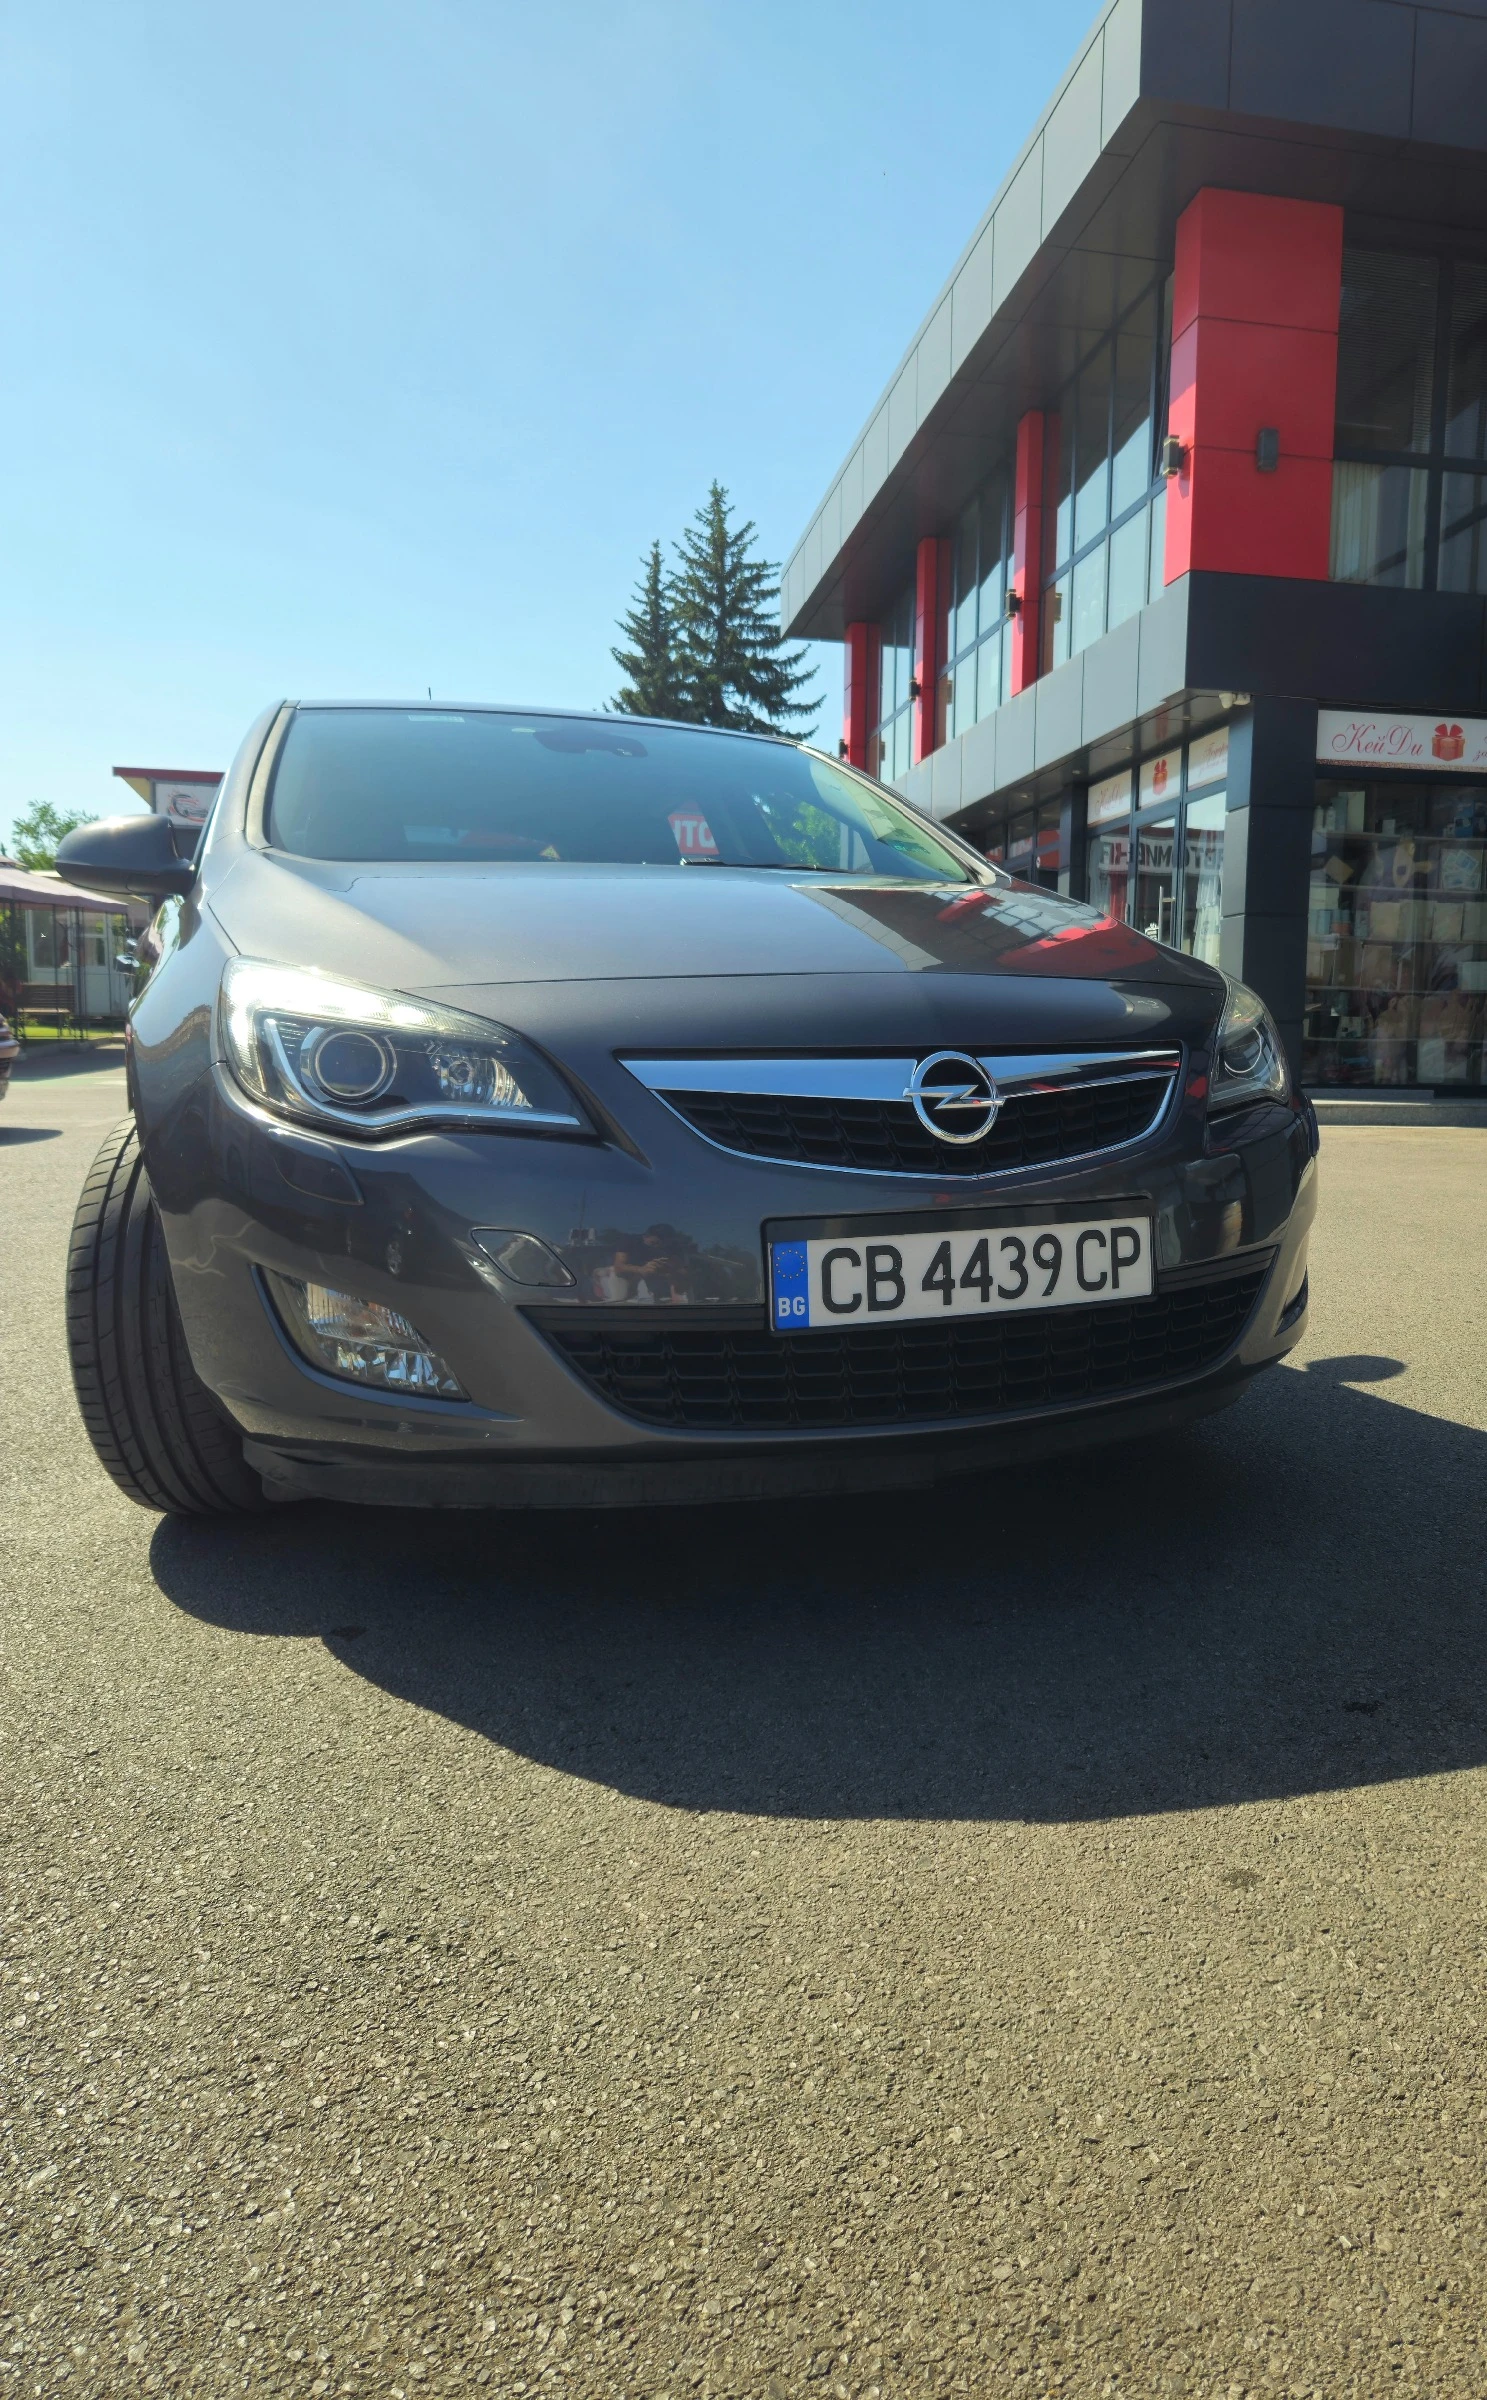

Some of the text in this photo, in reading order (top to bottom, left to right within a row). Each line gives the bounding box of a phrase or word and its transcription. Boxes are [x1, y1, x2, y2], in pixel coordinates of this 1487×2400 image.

[821, 1226, 1141, 1315] CB 4439 CP
[777, 1296, 806, 1318] BG
